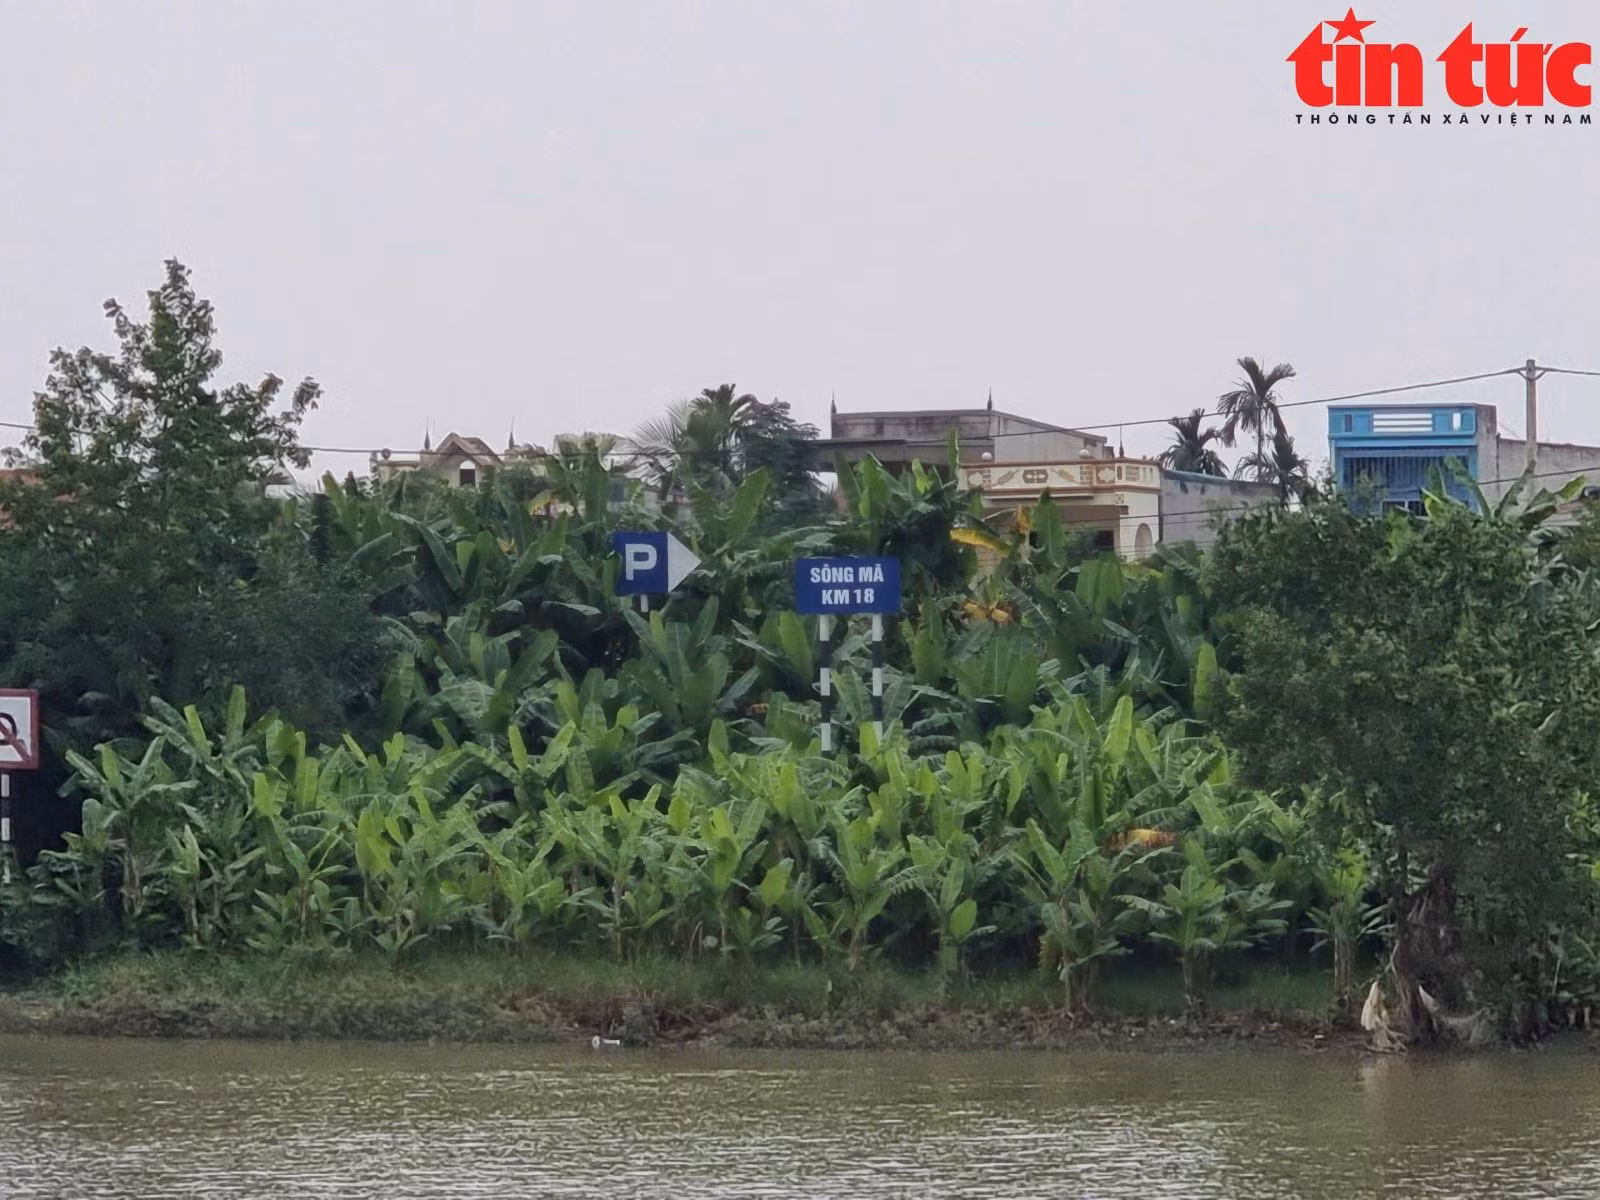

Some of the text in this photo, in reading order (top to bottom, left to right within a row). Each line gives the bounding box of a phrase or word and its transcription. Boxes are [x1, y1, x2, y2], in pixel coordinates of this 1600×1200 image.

[625, 543, 658, 581] P
[810, 563, 884, 583] SÔNG MÃ
[821, 588, 875, 605] KM 18
